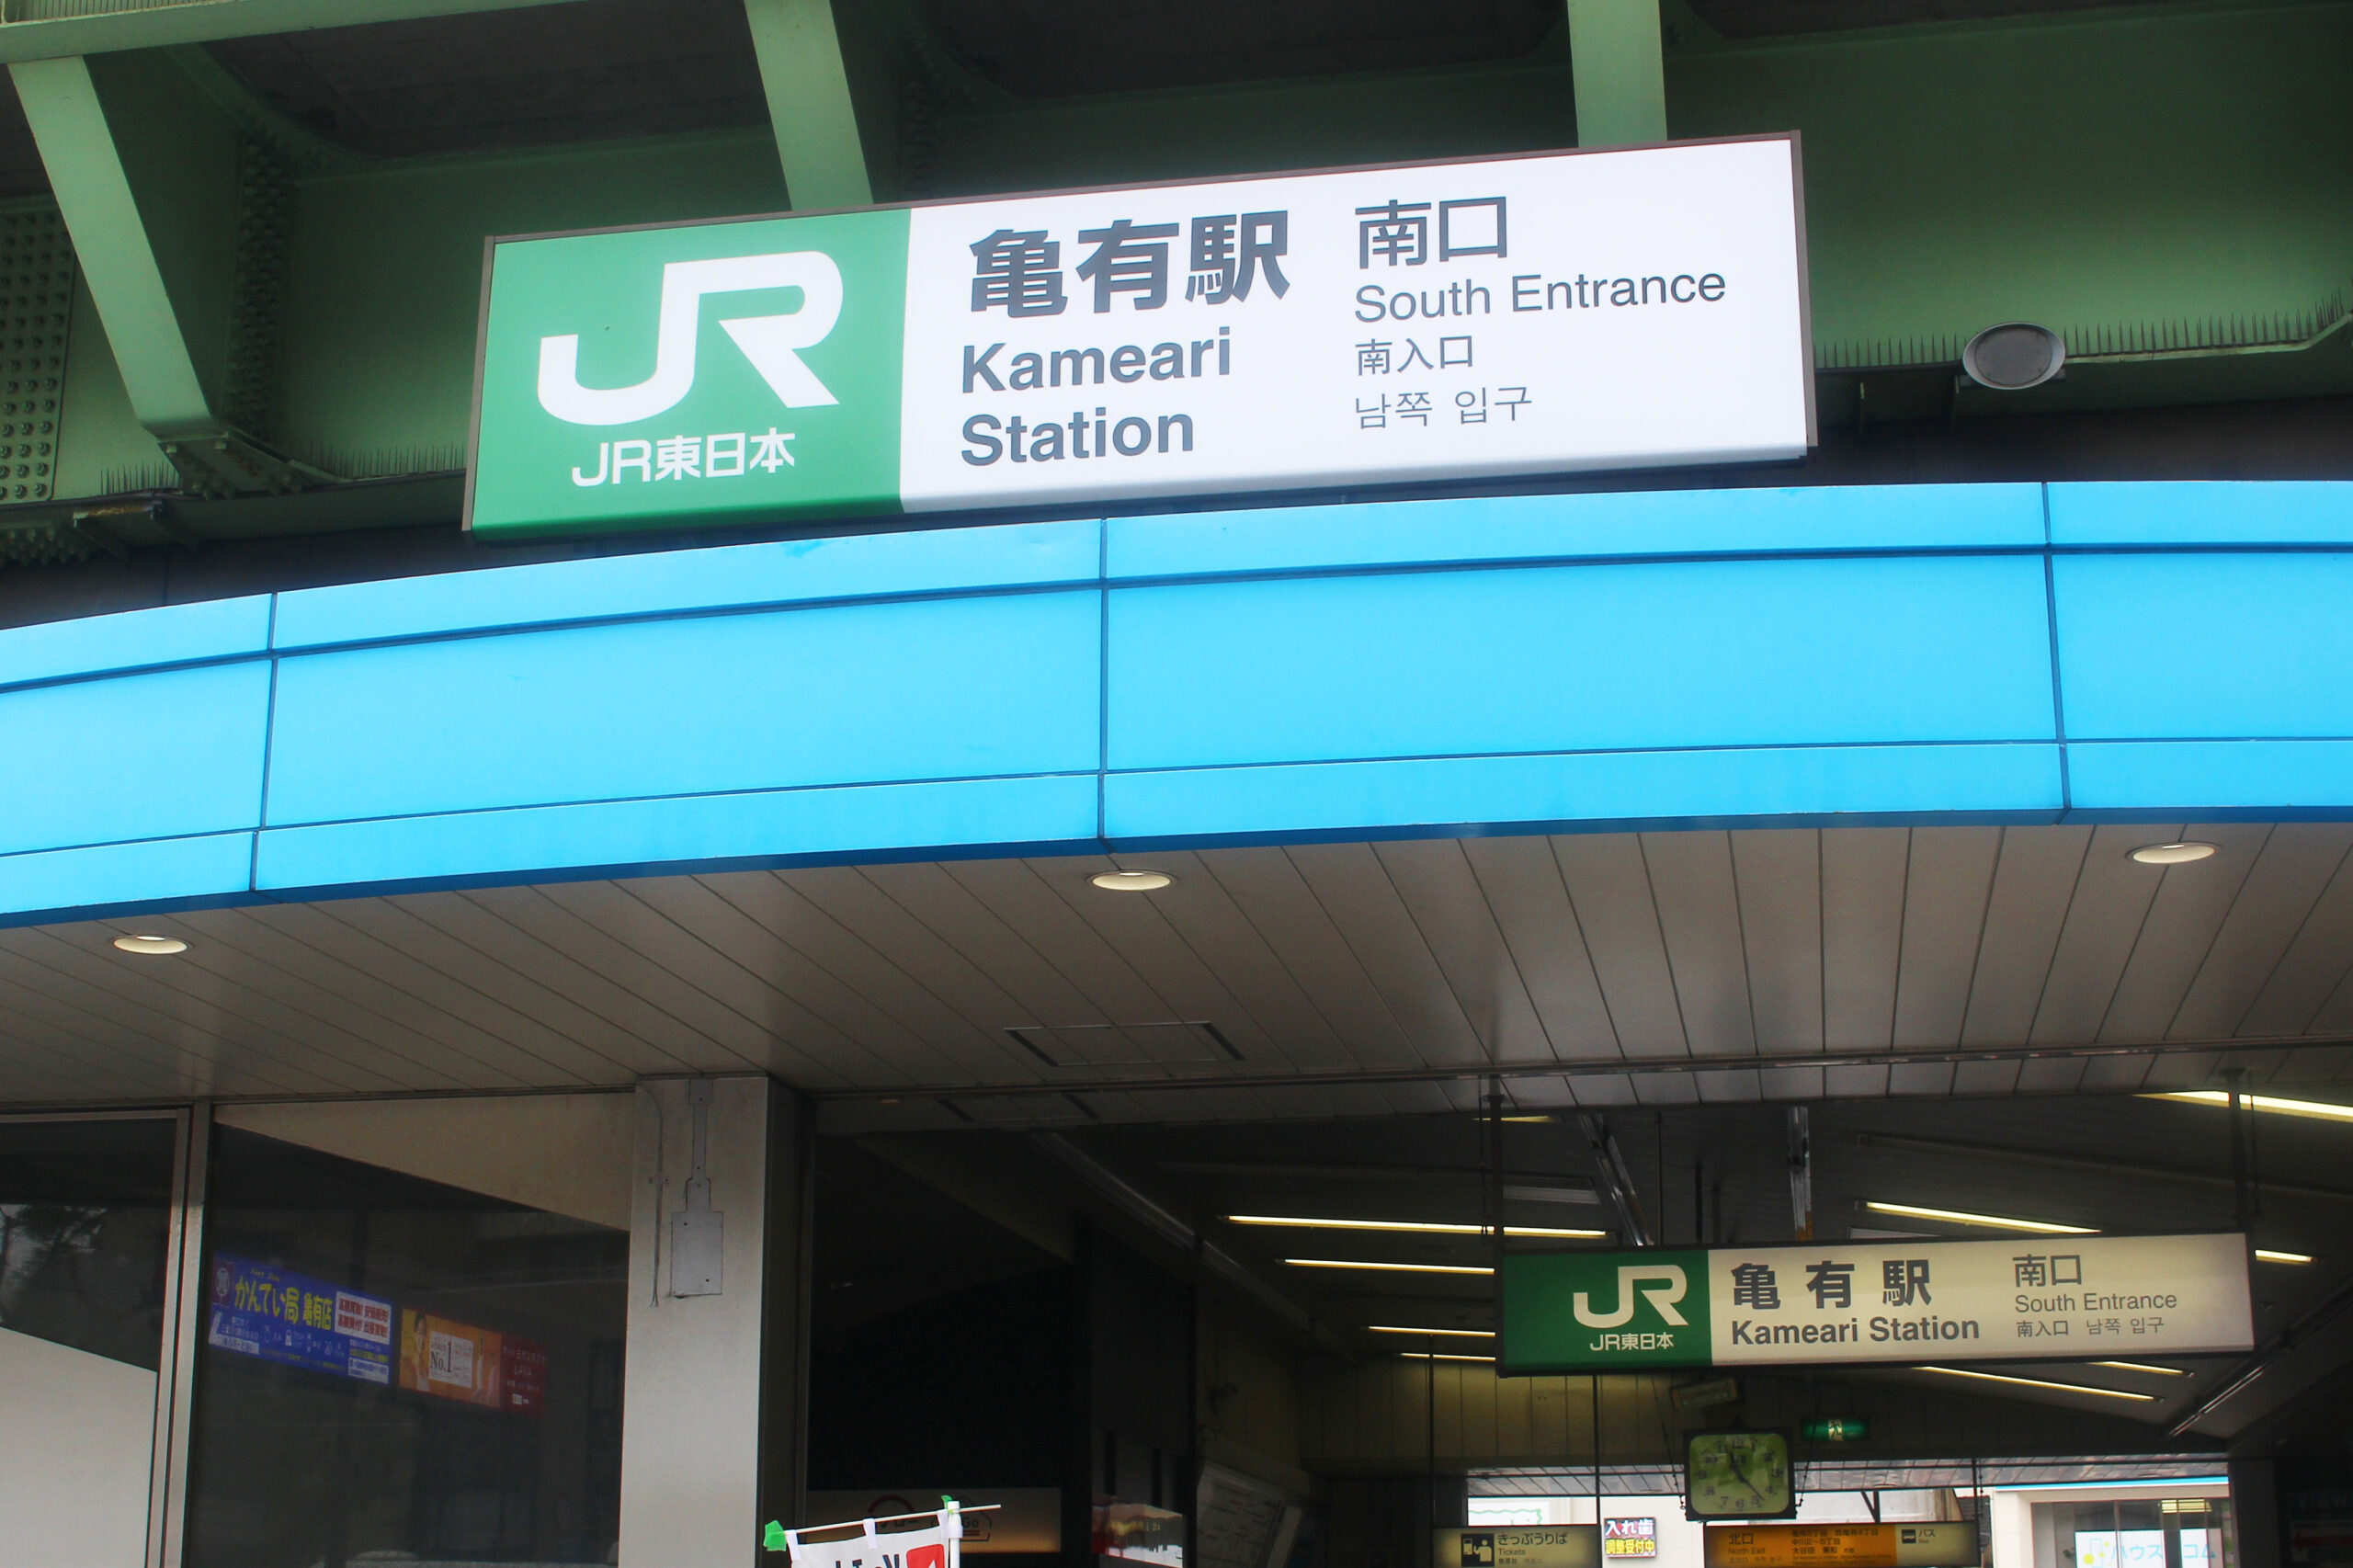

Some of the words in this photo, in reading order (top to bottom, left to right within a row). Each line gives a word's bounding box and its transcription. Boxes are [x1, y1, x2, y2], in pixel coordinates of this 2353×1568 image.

[1356, 197, 1507, 269] 南口
[970, 210, 1290, 318] 亀有駅
[1356, 278, 1491, 323] South
[1513, 273, 1726, 312] Entrance
[537, 251, 844, 426] JR
[963, 326, 1230, 393] Kameari
[1356, 335, 1473, 376] 南入口
[1356, 392, 1433, 430] 남쪽
[1455, 386, 1532, 424] 입구
[572, 426, 795, 487] JR東日本
[961, 406, 1194, 466] Station
[1730, 1259, 1932, 1310] 亀有駅
[2012, 1254, 2082, 1288] 南口
[1574, 1265, 1689, 1329] JR
[2015, 1293, 2075, 1313] South
[2083, 1292, 2177, 1310] Entrance
[1589, 1332, 1675, 1351] JR東日本
[1733, 1317, 1859, 1346] Kameari
[1870, 1315, 1980, 1342] Station
[2016, 1320, 2069, 1338] 南入口
[2086, 1318, 2121, 1335] 남쪽
[2130, 1317, 2165, 1335] 입구
[1605, 1518, 1654, 1536] 入れ歯
[1728, 1532, 1754, 1545] 北口
[1498, 1548, 1526, 1556] Tickets
